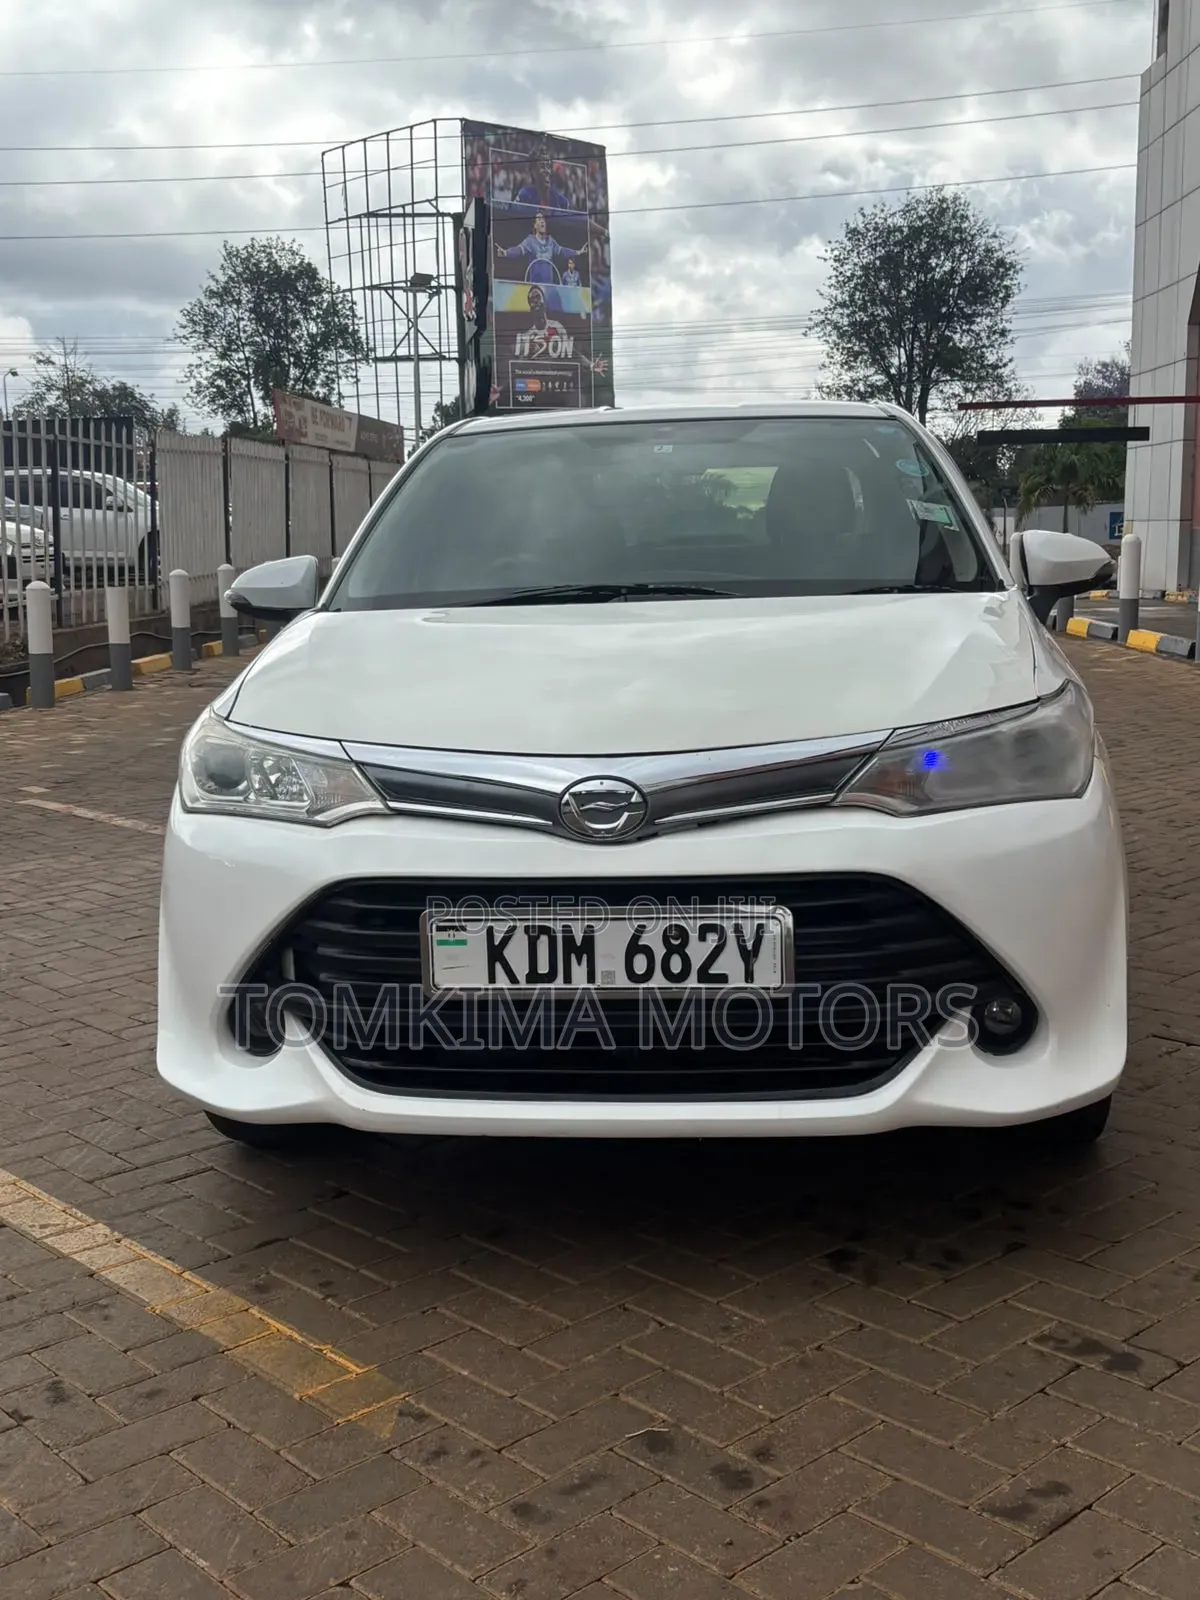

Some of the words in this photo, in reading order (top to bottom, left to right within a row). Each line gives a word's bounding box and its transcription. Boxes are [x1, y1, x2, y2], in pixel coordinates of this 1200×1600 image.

[548, 335, 574, 358] ON
[485, 924, 597, 985] KDM
[624, 923, 766, 985] 682Y
